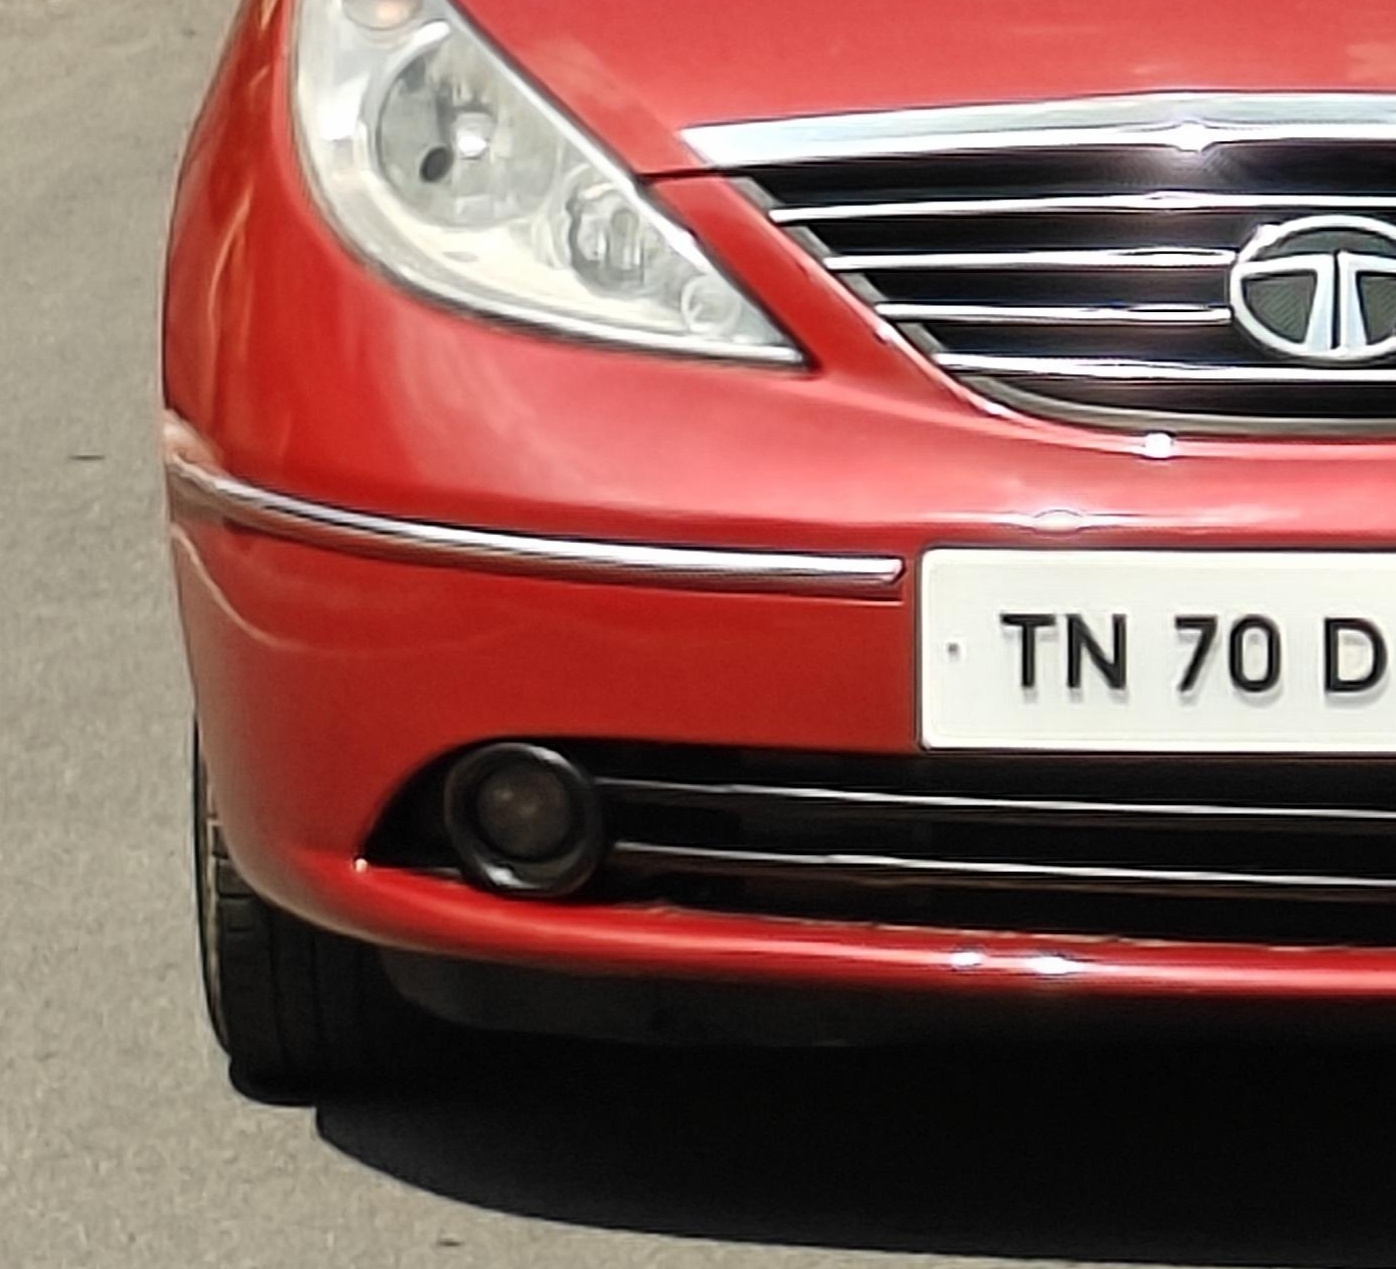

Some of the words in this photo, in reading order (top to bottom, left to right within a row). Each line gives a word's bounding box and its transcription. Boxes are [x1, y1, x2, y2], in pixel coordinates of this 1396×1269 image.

[1000, 613, 1127, 691] TN
[1174, 616, 1282, 693] 70
[1323, 617, 1388, 693] D
